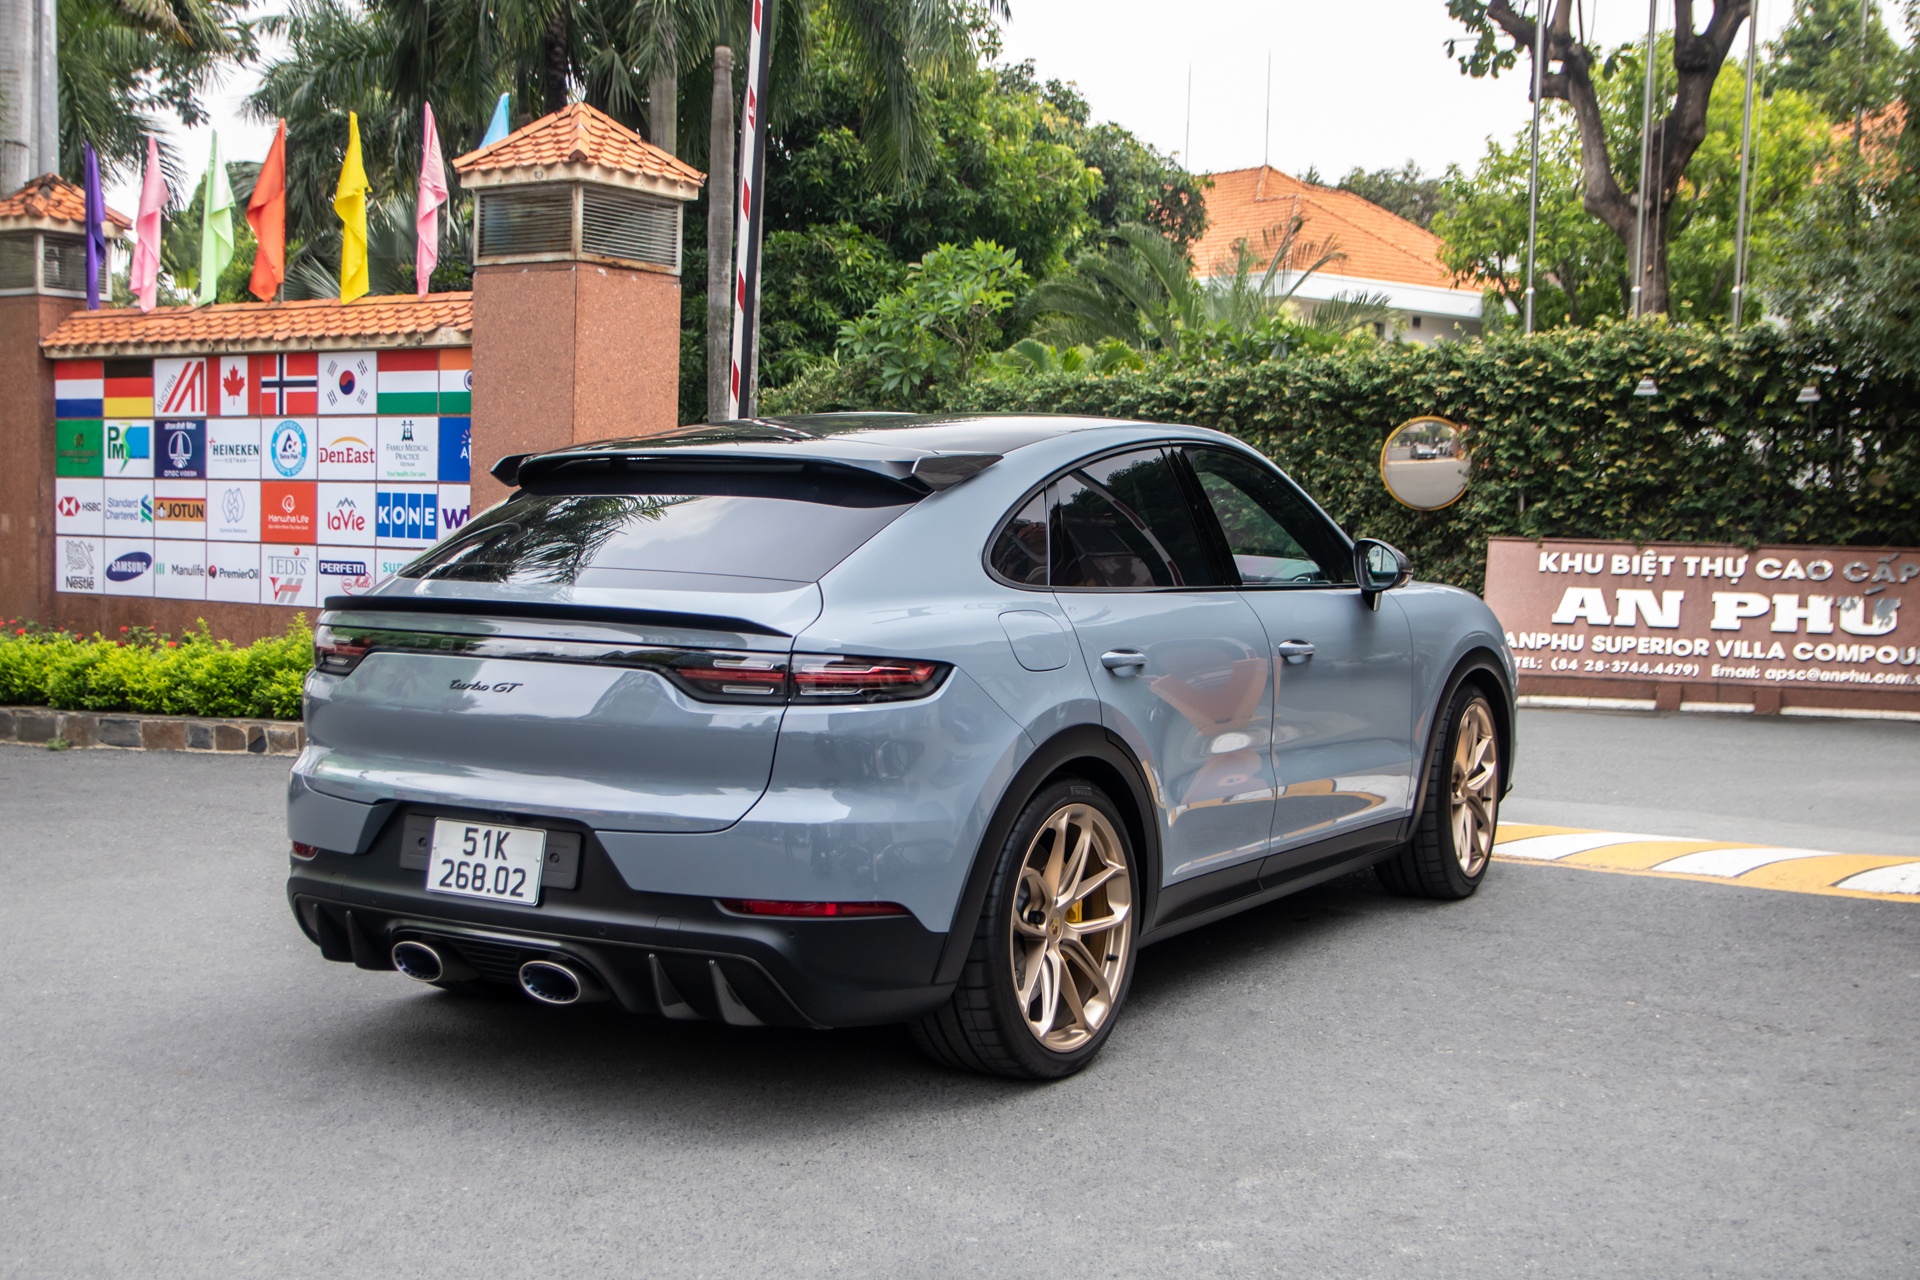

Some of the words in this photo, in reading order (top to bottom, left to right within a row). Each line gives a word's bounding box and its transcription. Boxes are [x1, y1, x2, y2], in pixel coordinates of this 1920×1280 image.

[157, 374, 177, 411] AUSTRIA
[213, 444, 259, 456] HEINEKEN
[386, 443, 404, 451] FAMILY
[405, 443, 429, 451] MEDICAL
[319, 447, 375, 463] DenEast
[395, 452, 420, 461] PRACTICE
[82, 502, 102, 512] HSBC
[107, 497, 138, 508] Standard
[105, 510, 138, 521] Chartered
[167, 503, 204, 518] JOTUN
[378, 505, 435, 527] KONE
[111, 561, 147, 573] SAMSUNG
[171, 564, 205, 577] Manulife
[268, 555, 309, 576] TEDIS
[320, 561, 364, 574] PERFETTI
[1538, 551, 1605, 574] KHU
[1610, 549, 1676, 582] BIỆT
[1683, 554, 1749, 585] THỰ
[1755, 558, 1834, 581] CAO
[1842, 552, 1920, 583] CẤP
[1551, 586, 1685, 629] AN
[1710, 584, 1902, 636] PHÚ
[1505, 631, 1585, 652] ANPHU
[1591, 633, 1710, 657] SUPERIOR
[1715, 639, 1786, 660] VILLA
[1514, 656, 1543, 670] TEL:
[1551, 656, 1578, 672] (84
[1711, 663, 1760, 680] Email:
[492, 682, 524, 694] GT
[462, 826, 511, 861] 51K
[439, 858, 527, 898] 268.02
